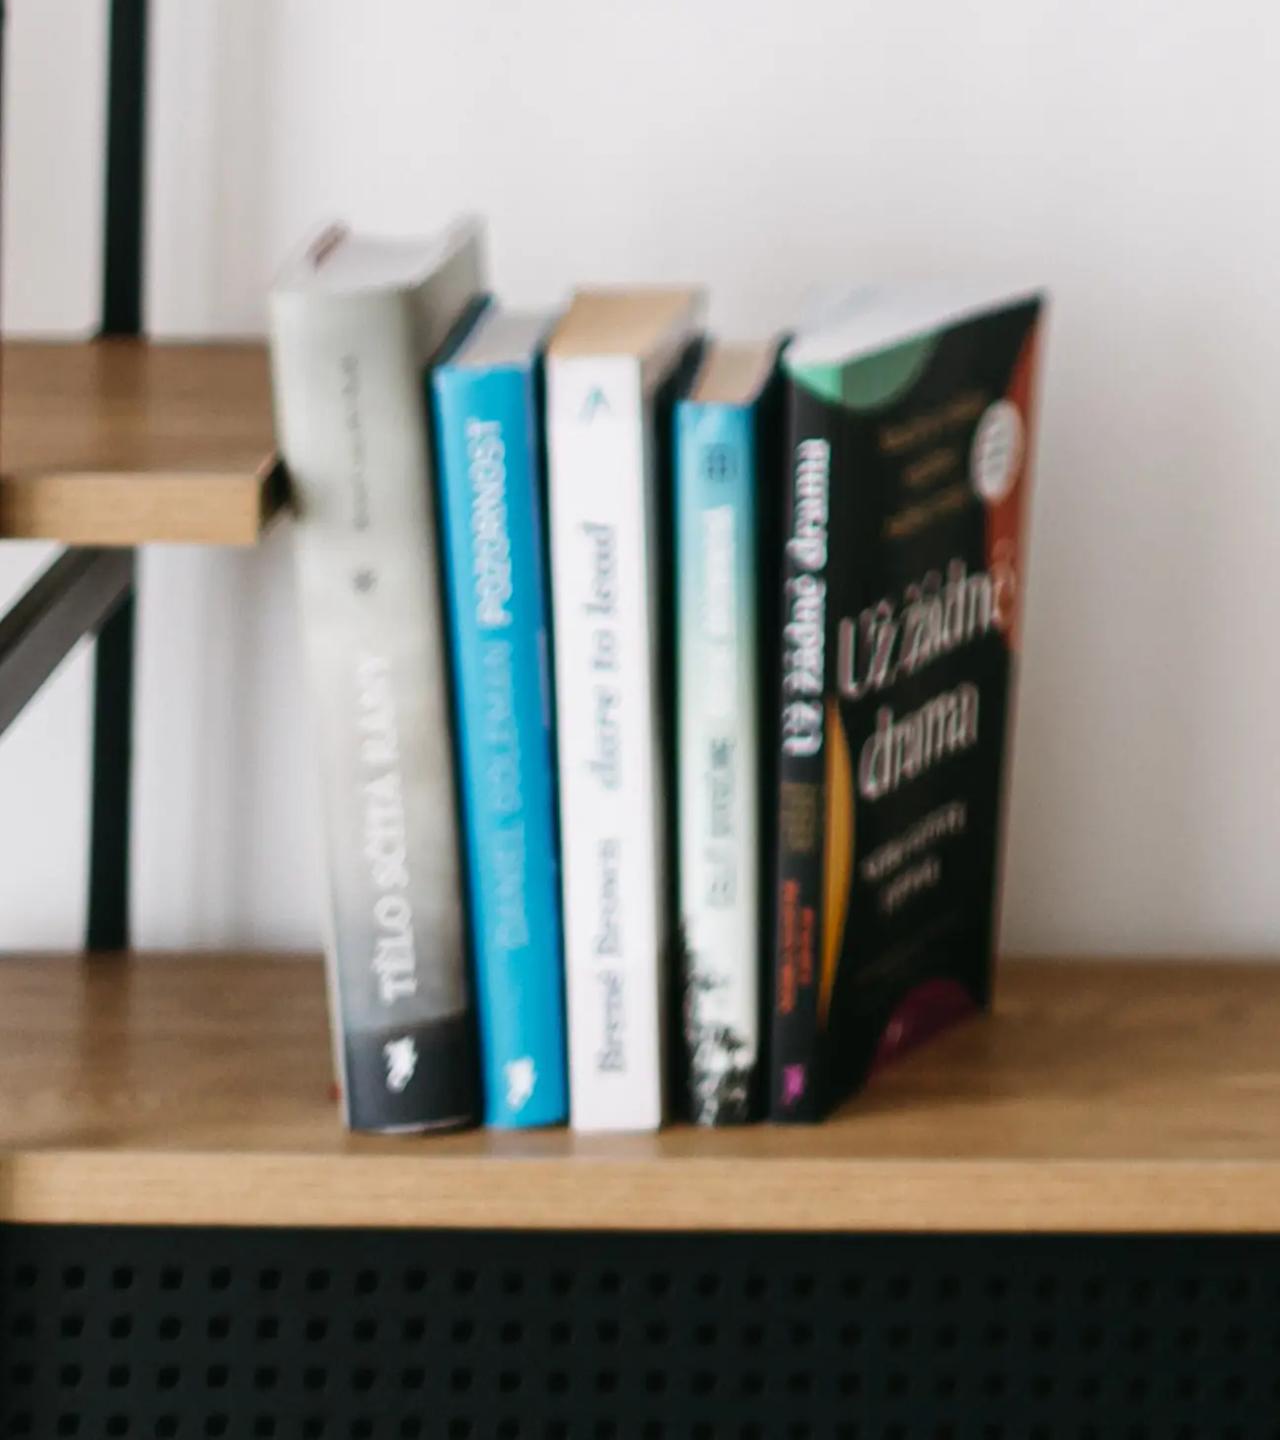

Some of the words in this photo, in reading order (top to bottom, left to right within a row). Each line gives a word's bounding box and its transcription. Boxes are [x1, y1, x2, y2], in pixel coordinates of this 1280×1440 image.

[464, 416, 515, 627] POZORNOST
[577, 519, 620, 618] lead
[588, 629, 620, 674] to
[580, 684, 622, 796] dare
